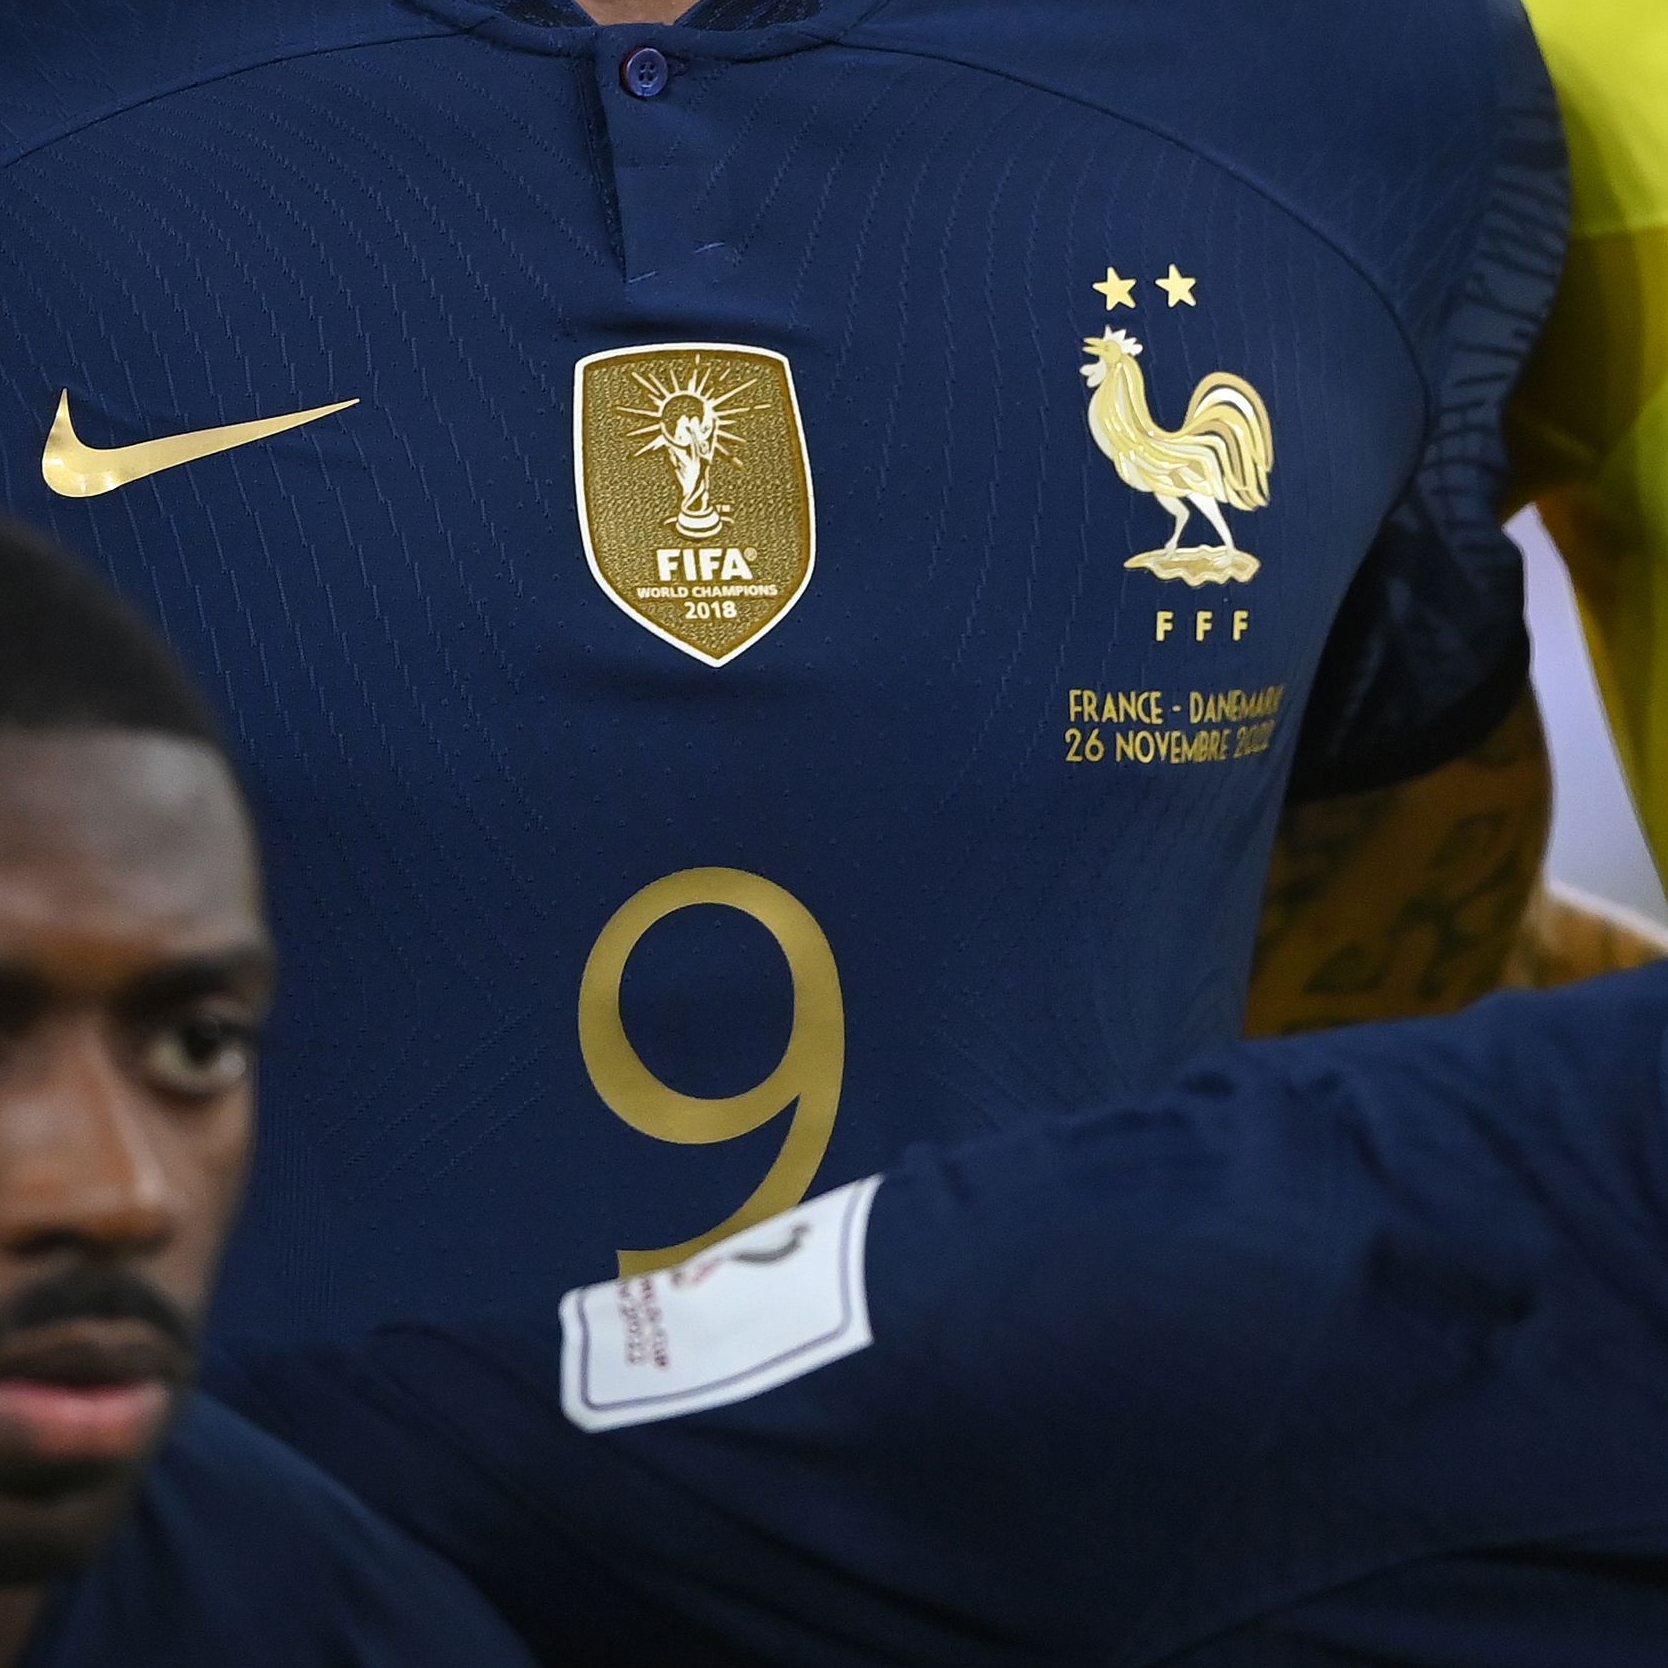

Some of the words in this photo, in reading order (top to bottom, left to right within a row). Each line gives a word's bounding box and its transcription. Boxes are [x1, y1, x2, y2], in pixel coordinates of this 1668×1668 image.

[656, 548, 754, 581] FIFA
[636, 586, 689, 599] WORLD
[691, 584, 778, 598] CHAMPIONS
[683, 600, 738, 620] 2018
[1068, 689, 1164, 724] FRANCE
[1065, 727, 1105, 762] 26
[1115, 728, 1231, 764] NOVEMBRE
[578, 865, 846, 1281] 9
